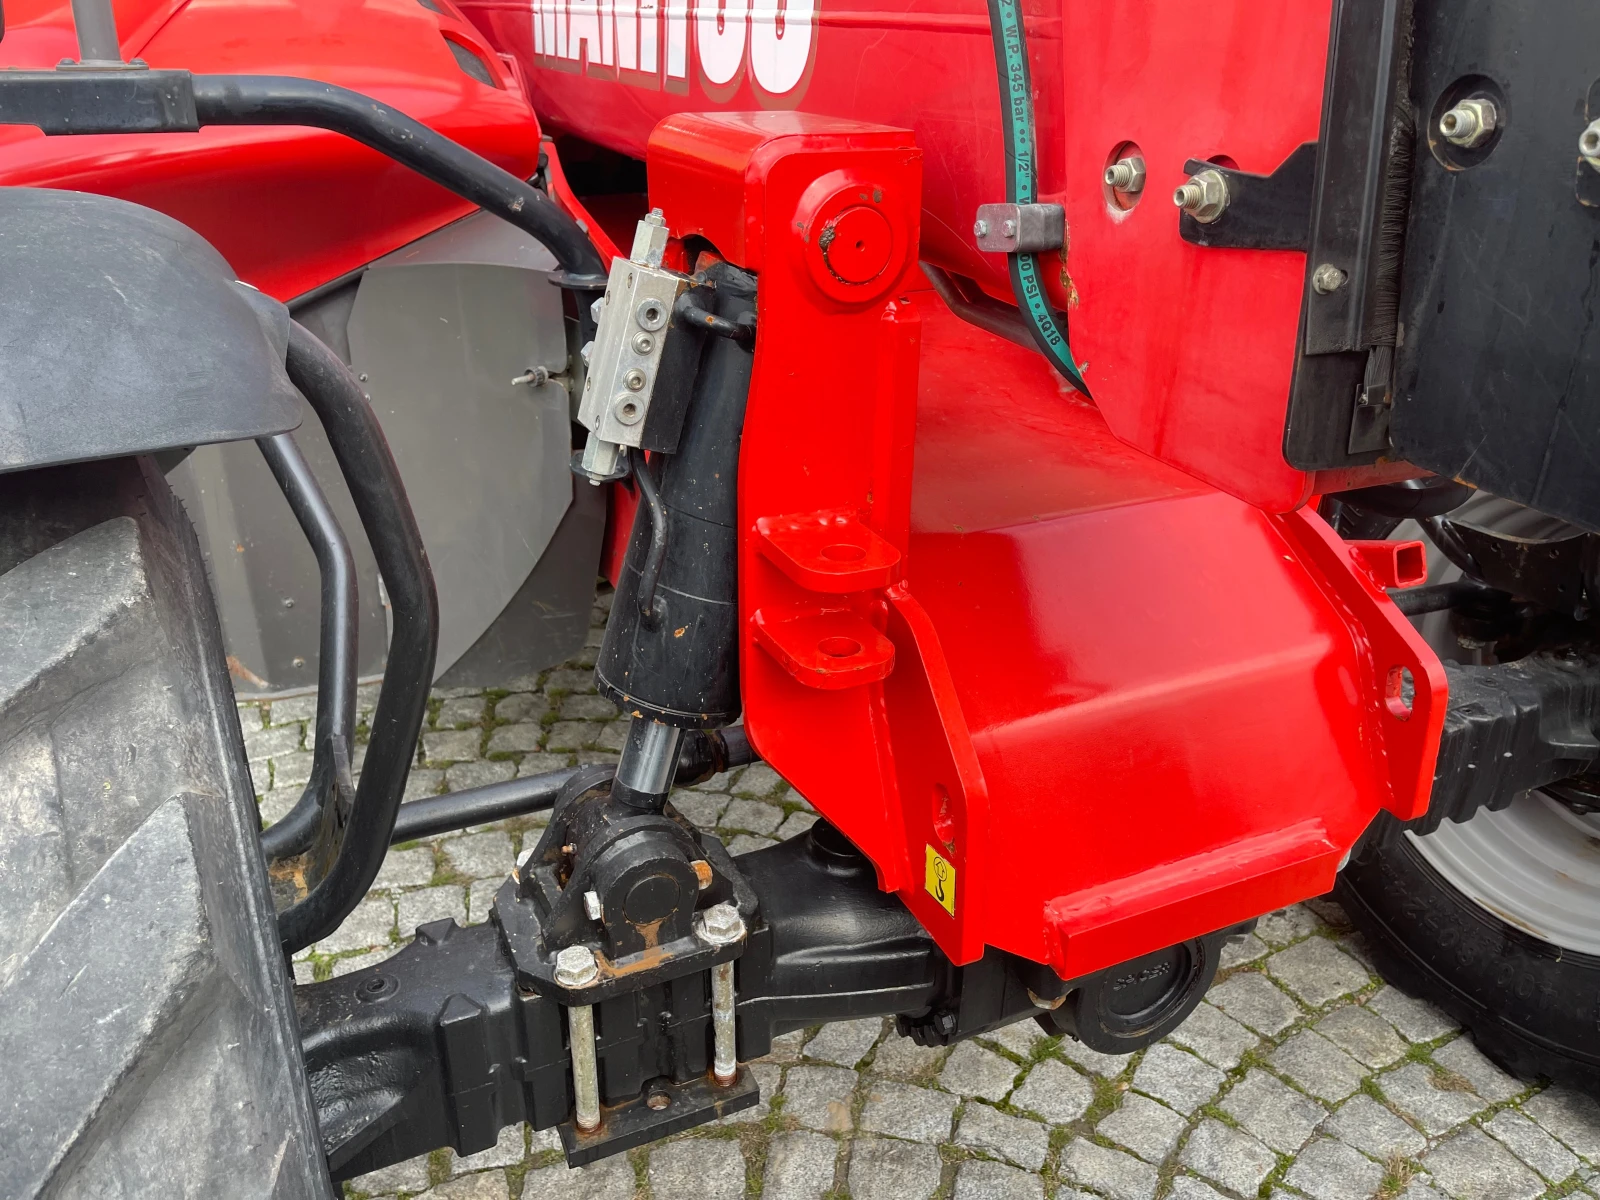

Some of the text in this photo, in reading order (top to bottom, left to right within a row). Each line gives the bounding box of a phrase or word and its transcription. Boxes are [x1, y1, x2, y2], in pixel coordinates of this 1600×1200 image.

[1005, 24, 1019, 58] W.P.
[1010, 65, 1024, 93] 345
[1014, 97, 1025, 122] bar
[1018, 151, 1030, 177] 1/2"
[1023, 276, 1039, 300] PSI
[1037, 314, 1061, 346] 4Q18
